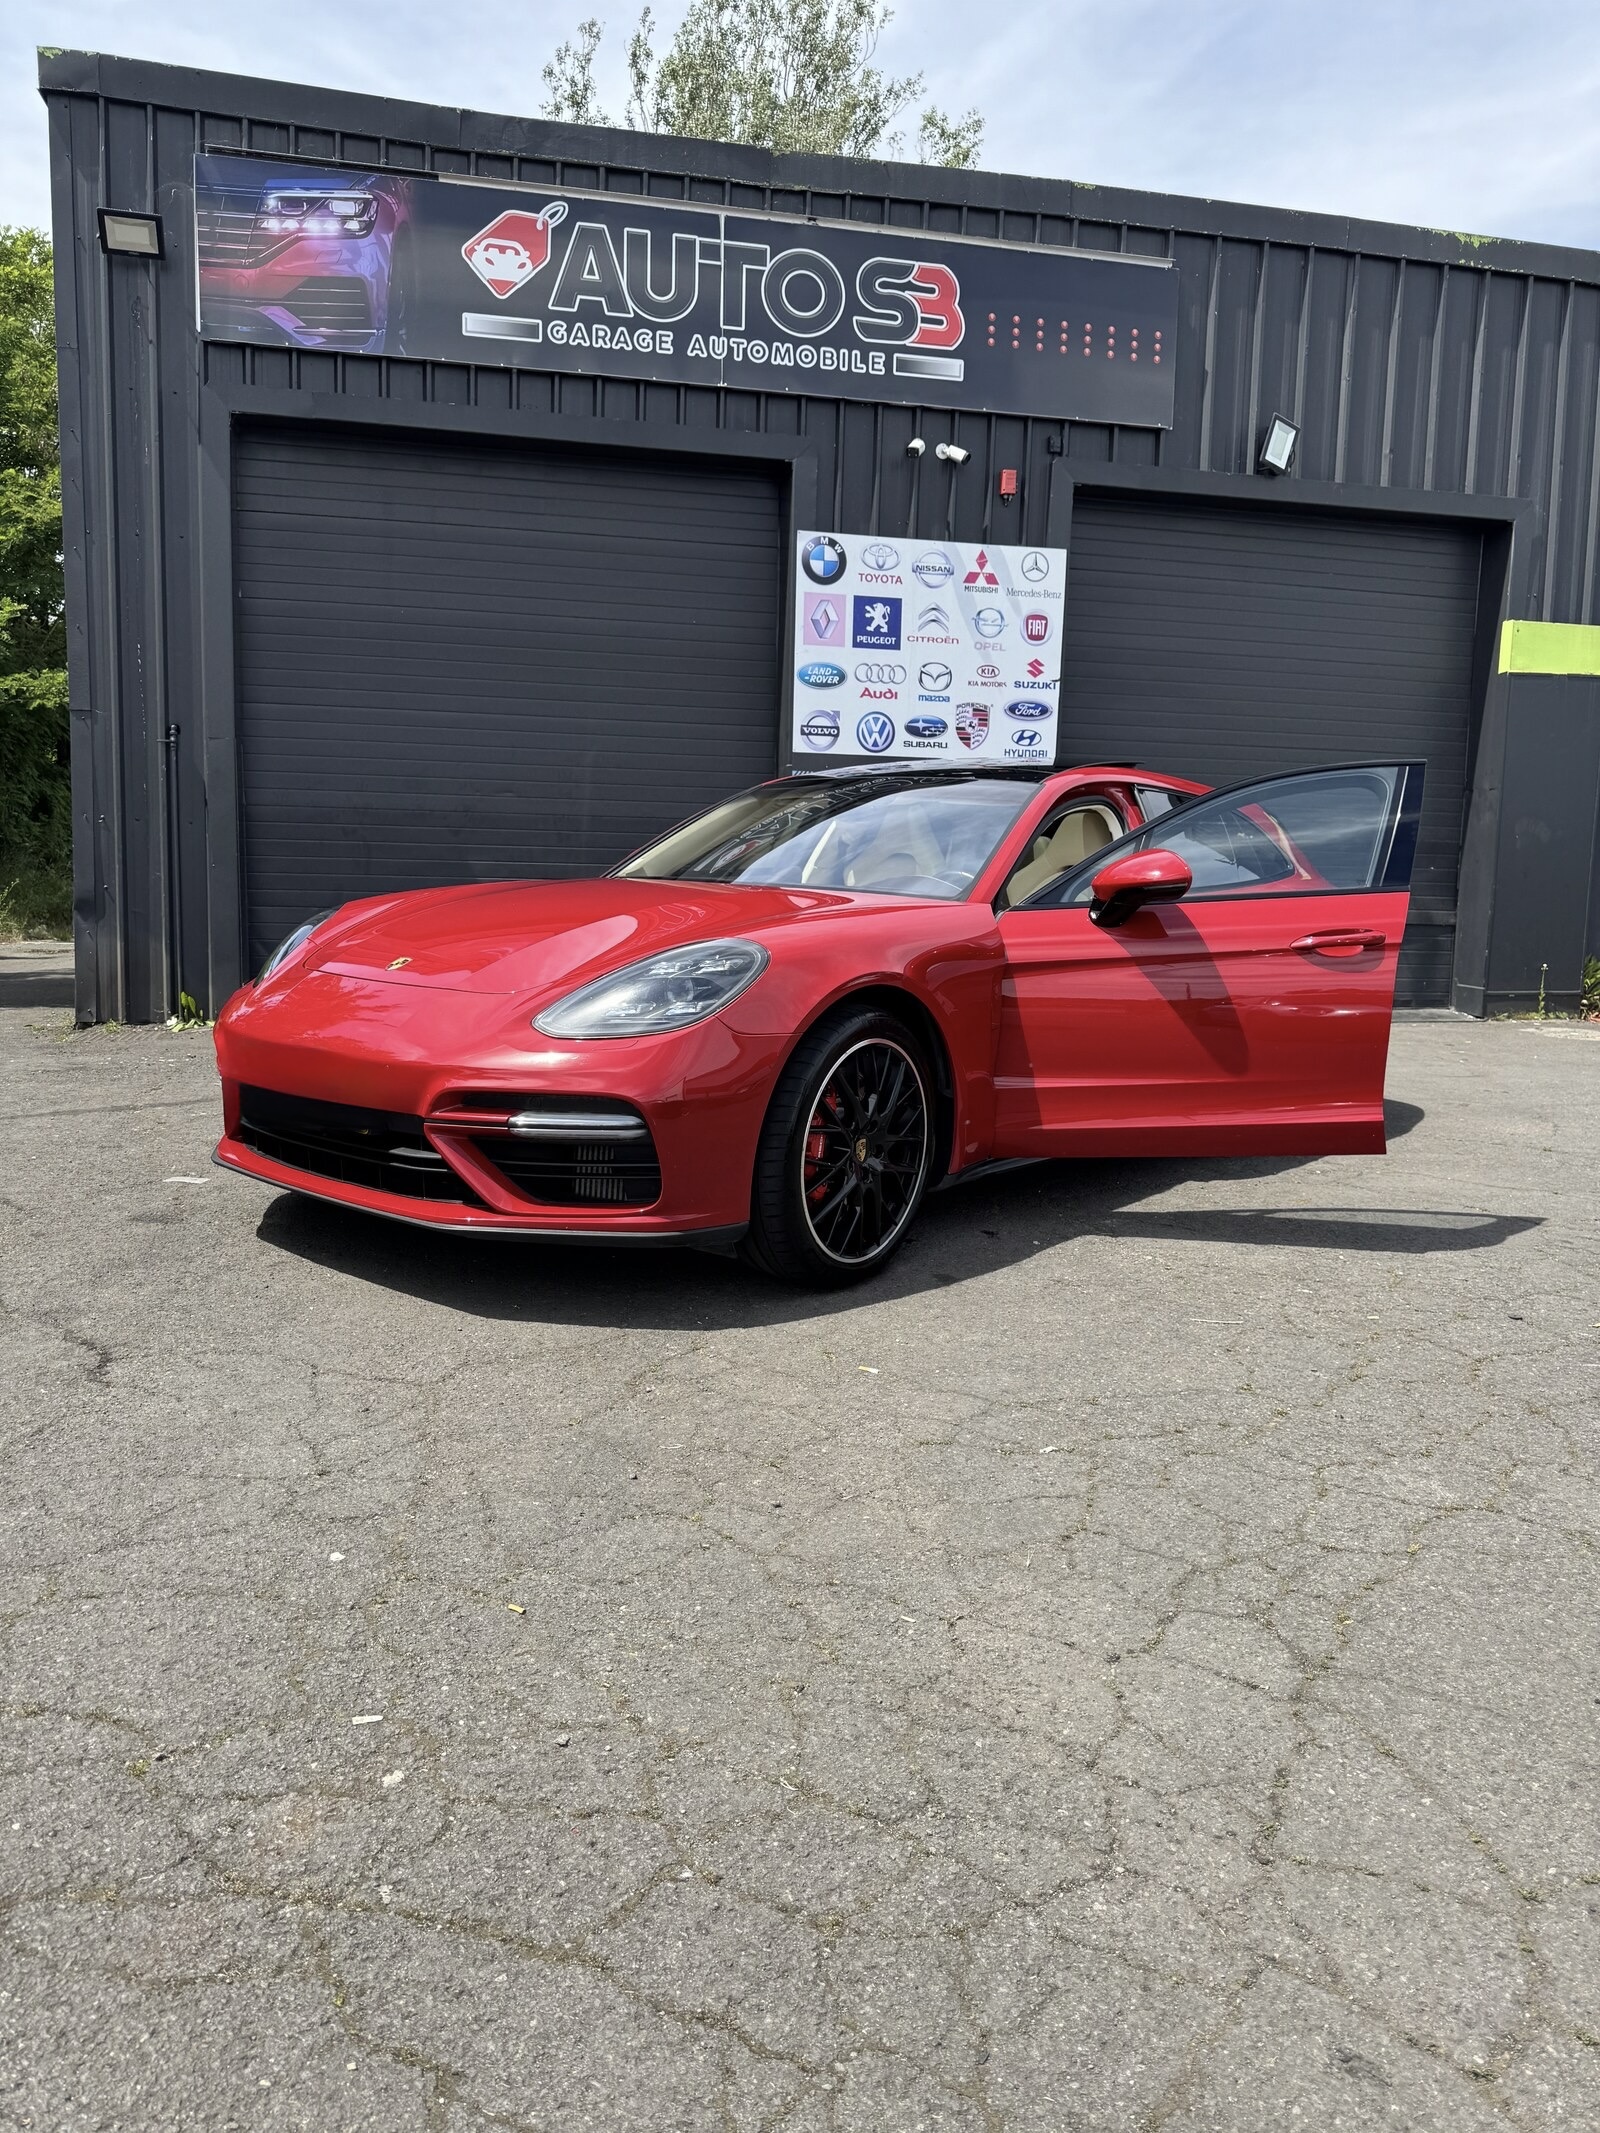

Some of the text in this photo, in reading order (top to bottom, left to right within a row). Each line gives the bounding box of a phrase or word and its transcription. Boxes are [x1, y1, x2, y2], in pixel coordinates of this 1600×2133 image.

[546, 319, 886, 375] GARAGE AUTOMOBILE
[915, 563, 951, 573] NISSAN
[858, 572, 903, 586] TOYOTA
[964, 585, 999, 594] MITSUBISHI
[1006, 587, 1062, 600] Mercedes-Benz
[1028, 619, 1046, 636] FIAT
[856, 635, 897, 645] PEUGEOT
[974, 641, 1006, 652] OPEL
[980, 667, 997, 676] KIA
[1013, 680, 1057, 690] SUZUKI
[860, 687, 898, 699] Audi
[956, 702, 989, 710] PORSCHE
[1014, 704, 1042, 717] Ford
[802, 726, 838, 736] VOLVO
[903, 739, 948, 749] SUBARU
[1004, 747, 1048, 758] HYUNDAI
